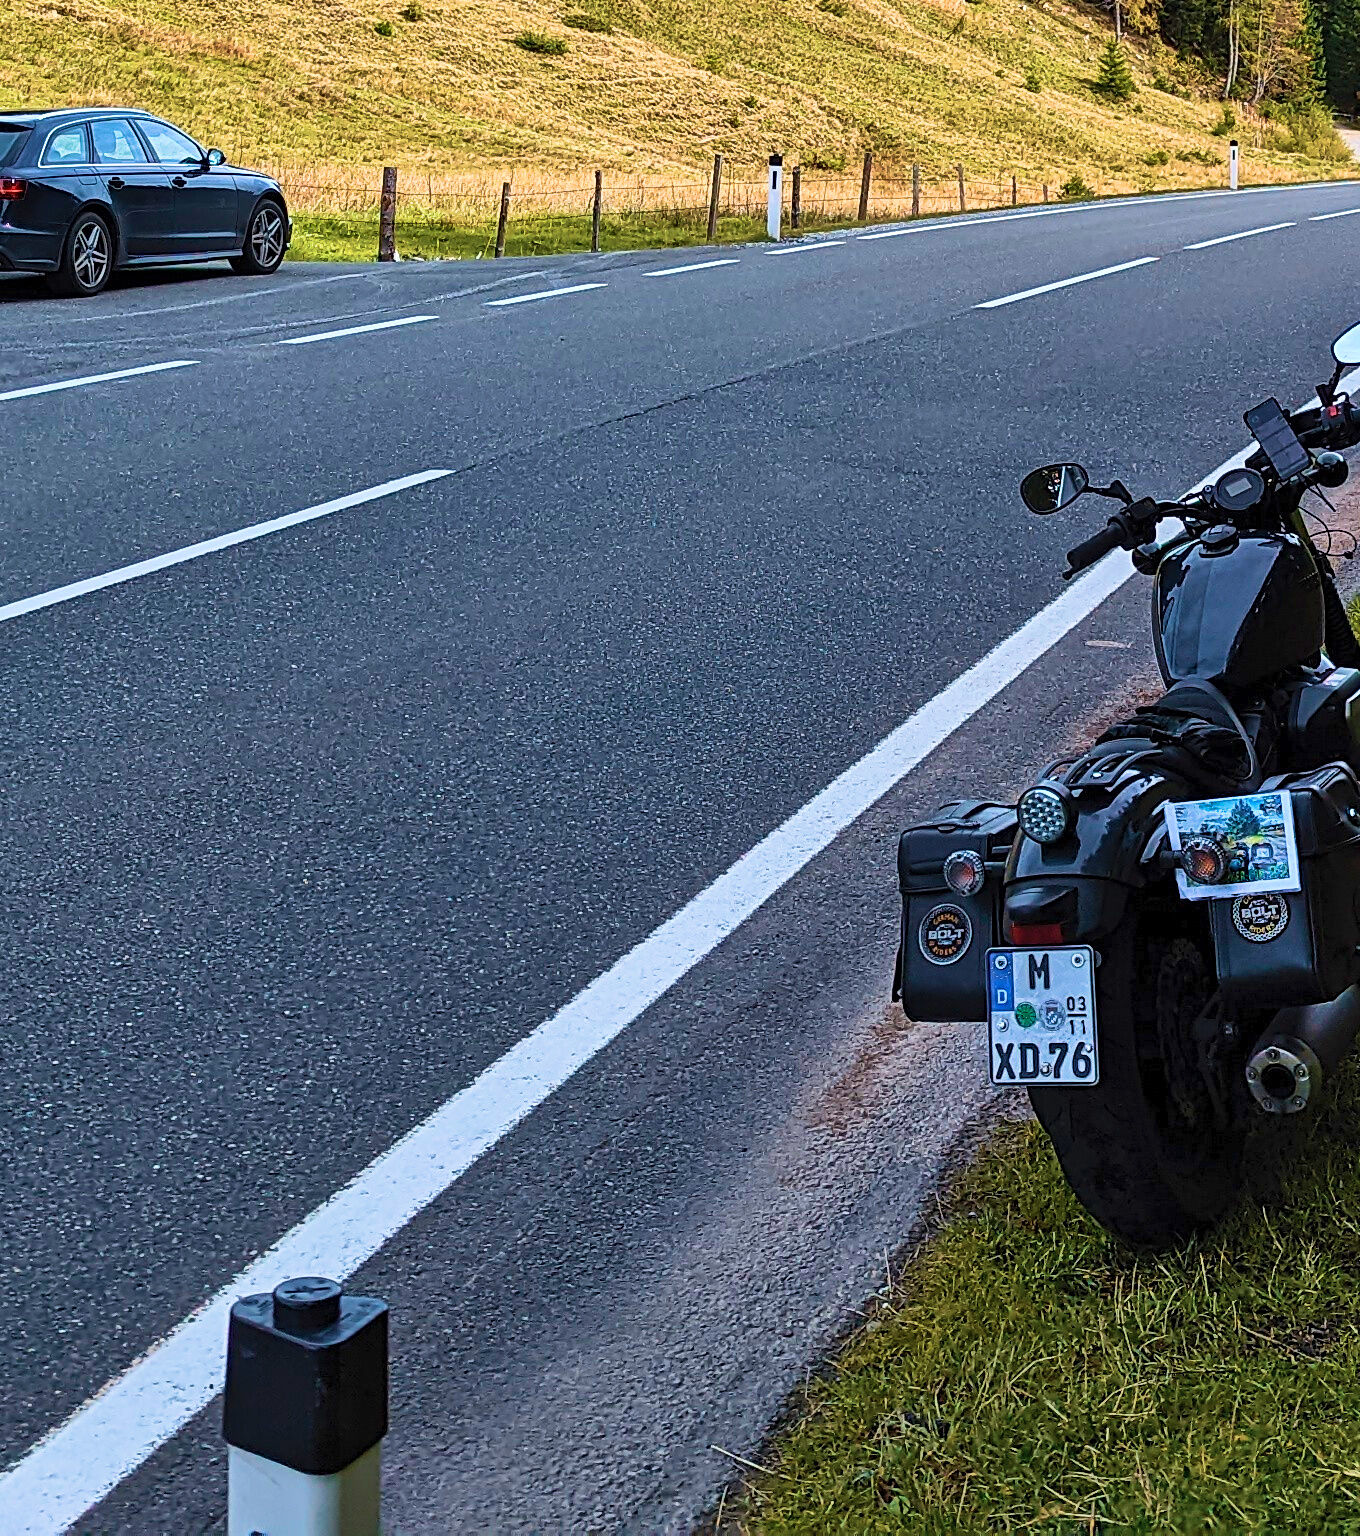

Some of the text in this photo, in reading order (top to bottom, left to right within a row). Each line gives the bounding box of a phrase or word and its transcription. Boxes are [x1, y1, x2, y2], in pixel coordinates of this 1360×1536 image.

[1241, 904, 1279, 919] BOLT
[928, 928, 965, 940] BOLT
[1028, 953, 1051, 990] M
[997, 989, 1008, 1004] D
[1066, 996, 1087, 1012] 03
[1069, 1019, 1087, 1035] 11
